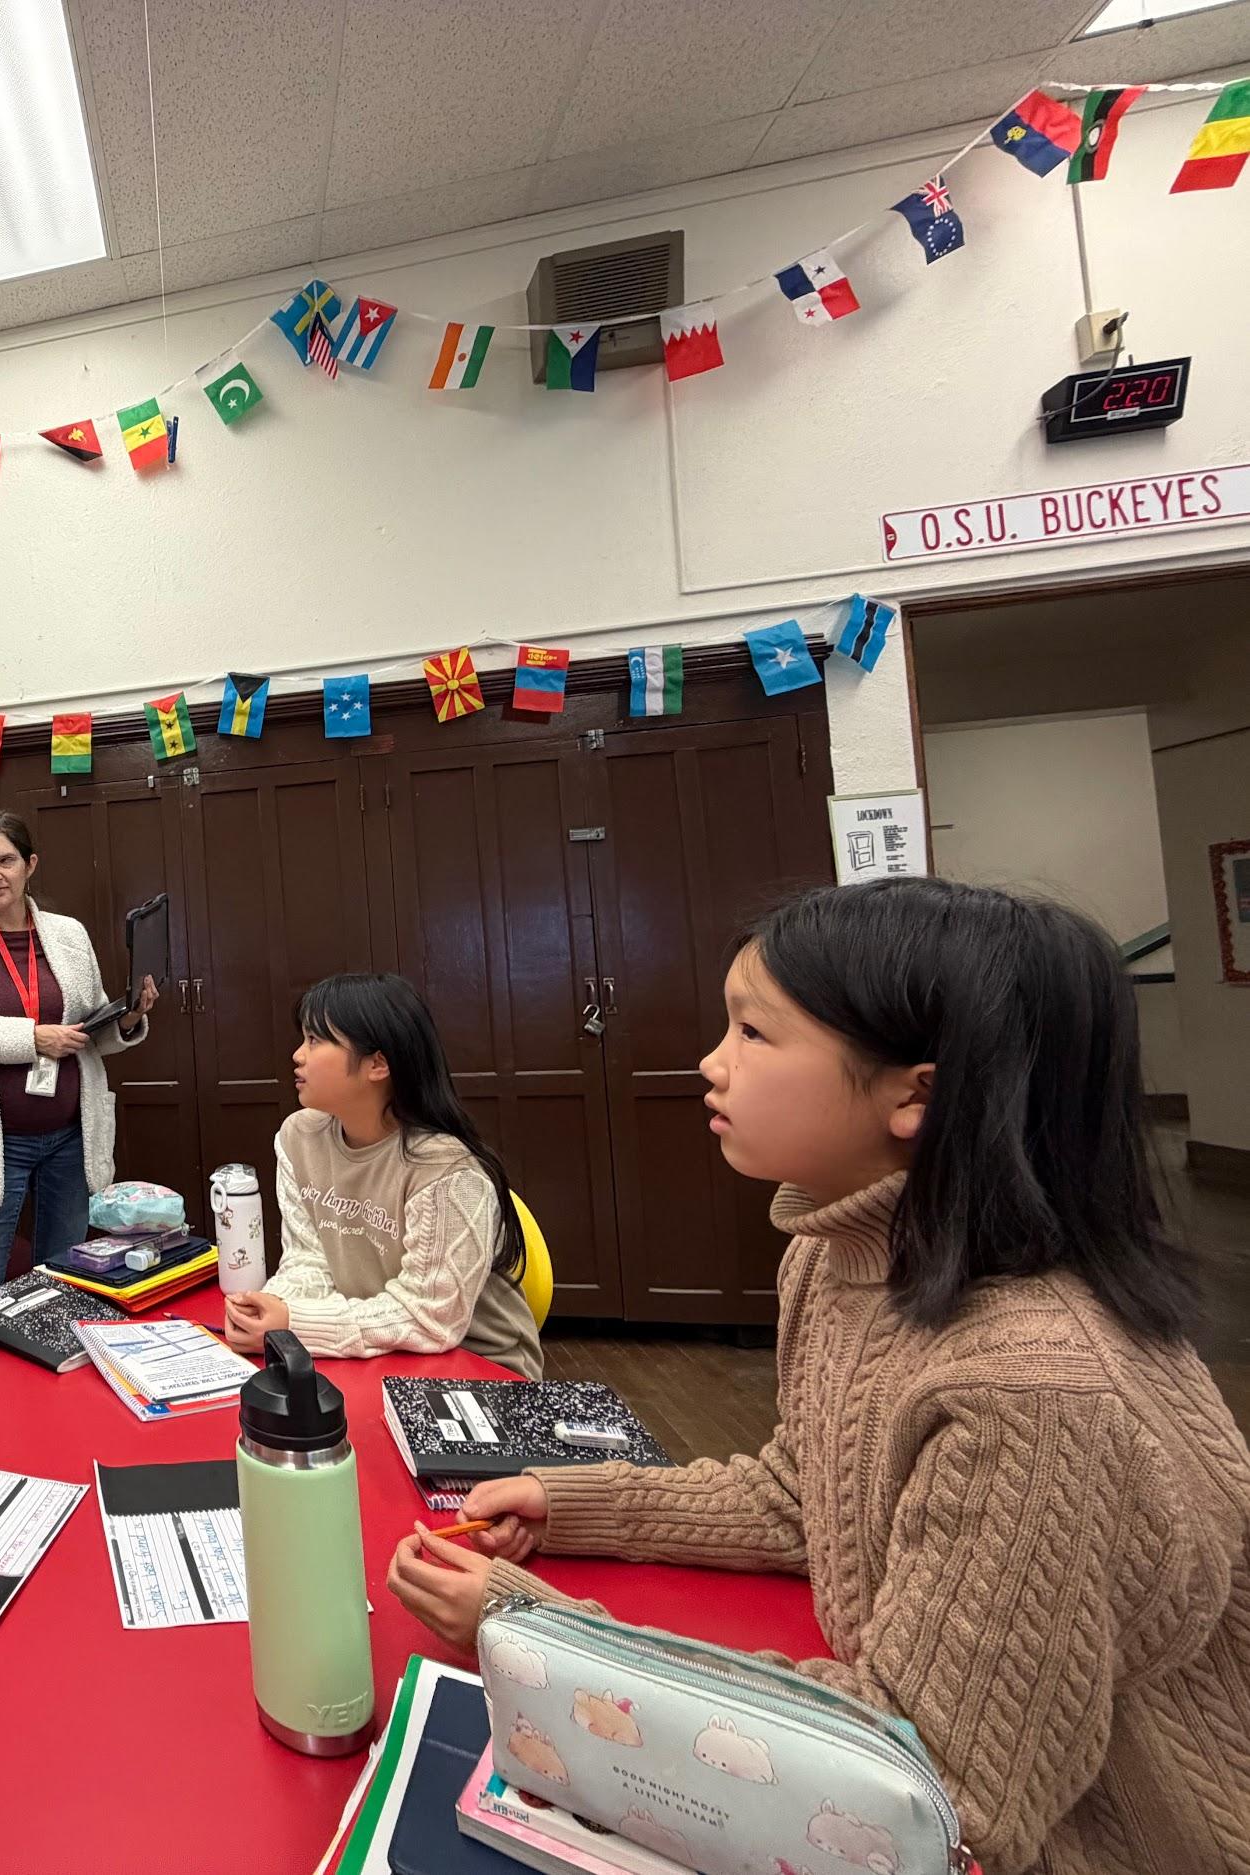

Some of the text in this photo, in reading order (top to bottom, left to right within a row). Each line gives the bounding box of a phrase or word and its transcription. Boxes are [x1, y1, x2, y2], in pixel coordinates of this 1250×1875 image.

[920, 474, 1223, 551] O.S.U. BUCKEYES
[856, 807, 894, 822] LOCKDOWN
[613, 1765, 646, 1785] GOOD
[649, 1780, 686, 1802] NIGHT
[622, 1781, 629, 1790] A
[634, 1786, 670, 1807] LITTLE
